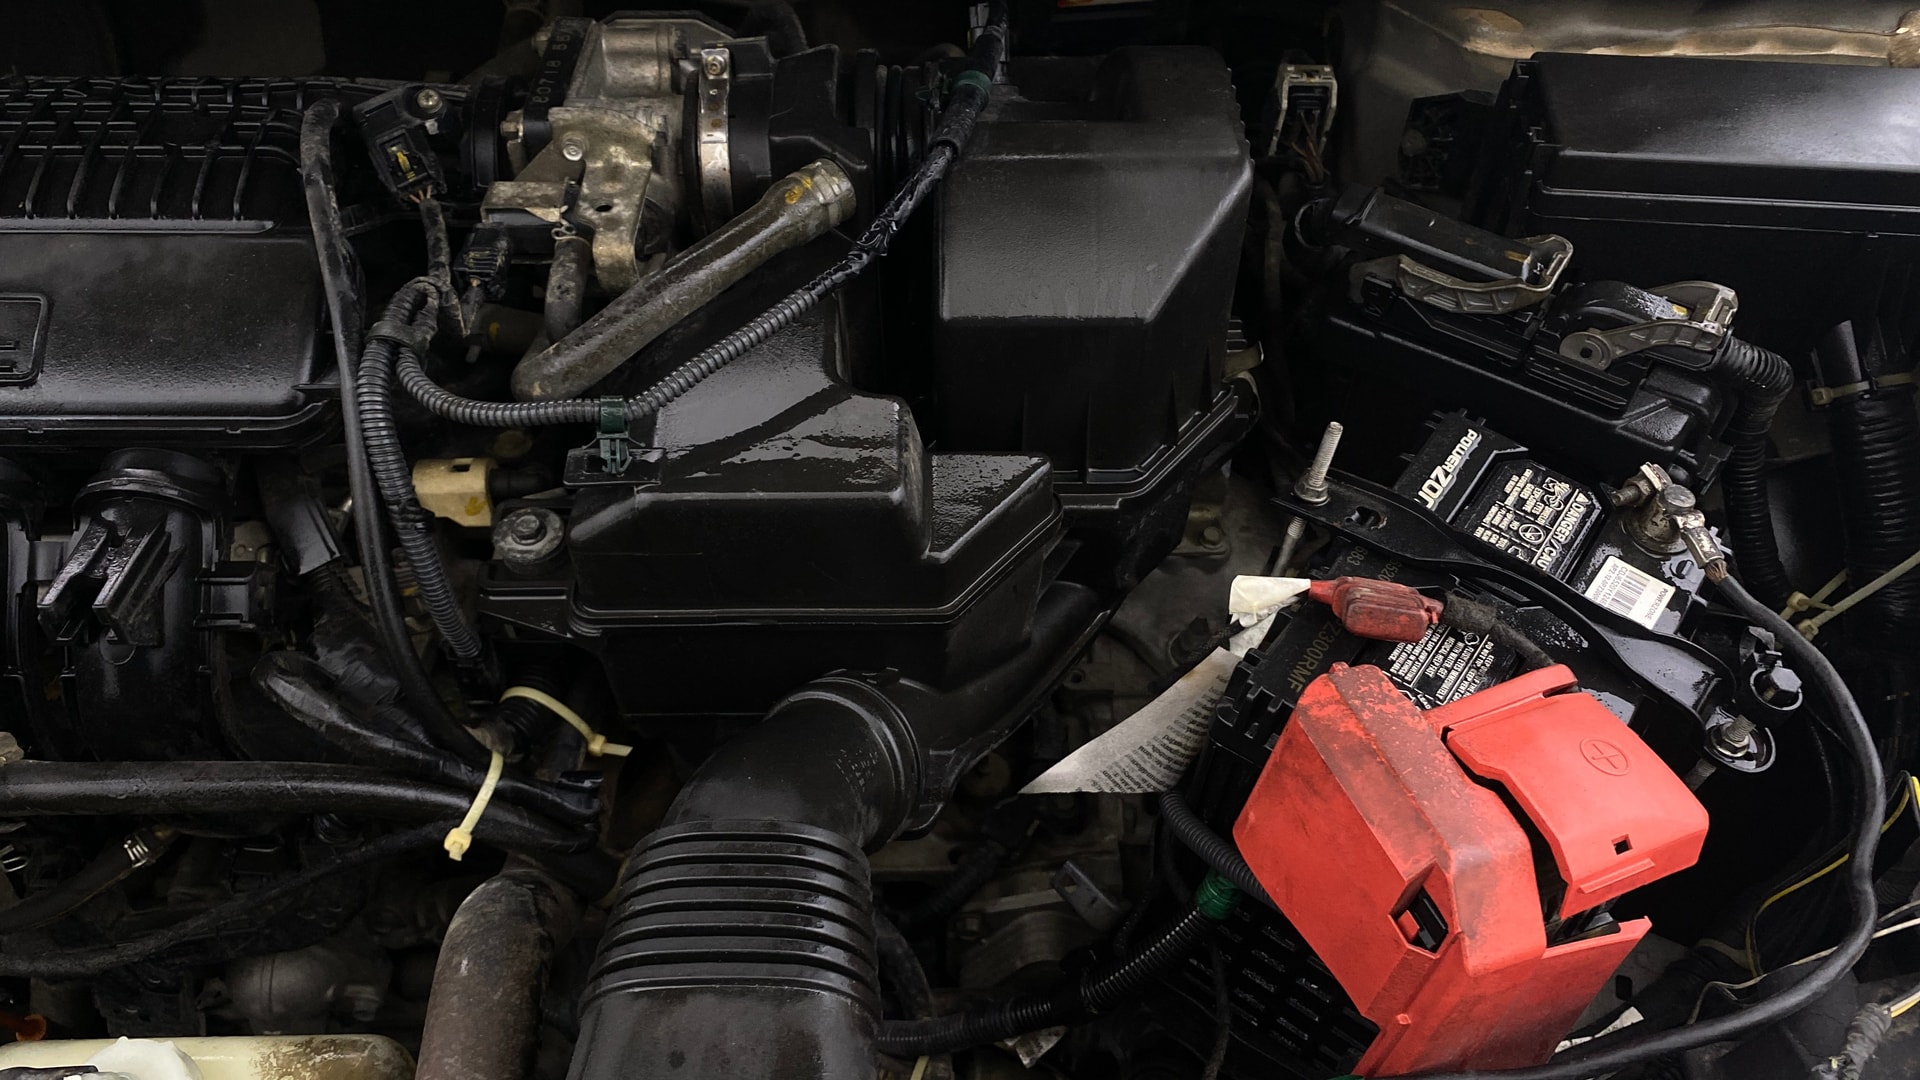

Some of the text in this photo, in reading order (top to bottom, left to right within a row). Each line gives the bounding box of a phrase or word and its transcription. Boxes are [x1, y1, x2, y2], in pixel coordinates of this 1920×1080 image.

[1509, 519, 1520, 530] NO
[1537, 502, 1584, 571] DANGER/CAU
[1644, 587, 1668, 620] POWERZONE
[1438, 637, 1455, 655] MEDICAL
[1452, 642, 1465, 654] WITH
[1291, 618, 1342, 692] Z300RMF
[1432, 653, 1444, 666] HELP
[1425, 664, 1438, 677] FAST
[1436, 667, 1448, 678] GET
[1453, 659, 1466, 672] EYES
[1436, 669, 1459, 700] IMMEDIATELY
[1417, 694, 1432, 710] LEAD
